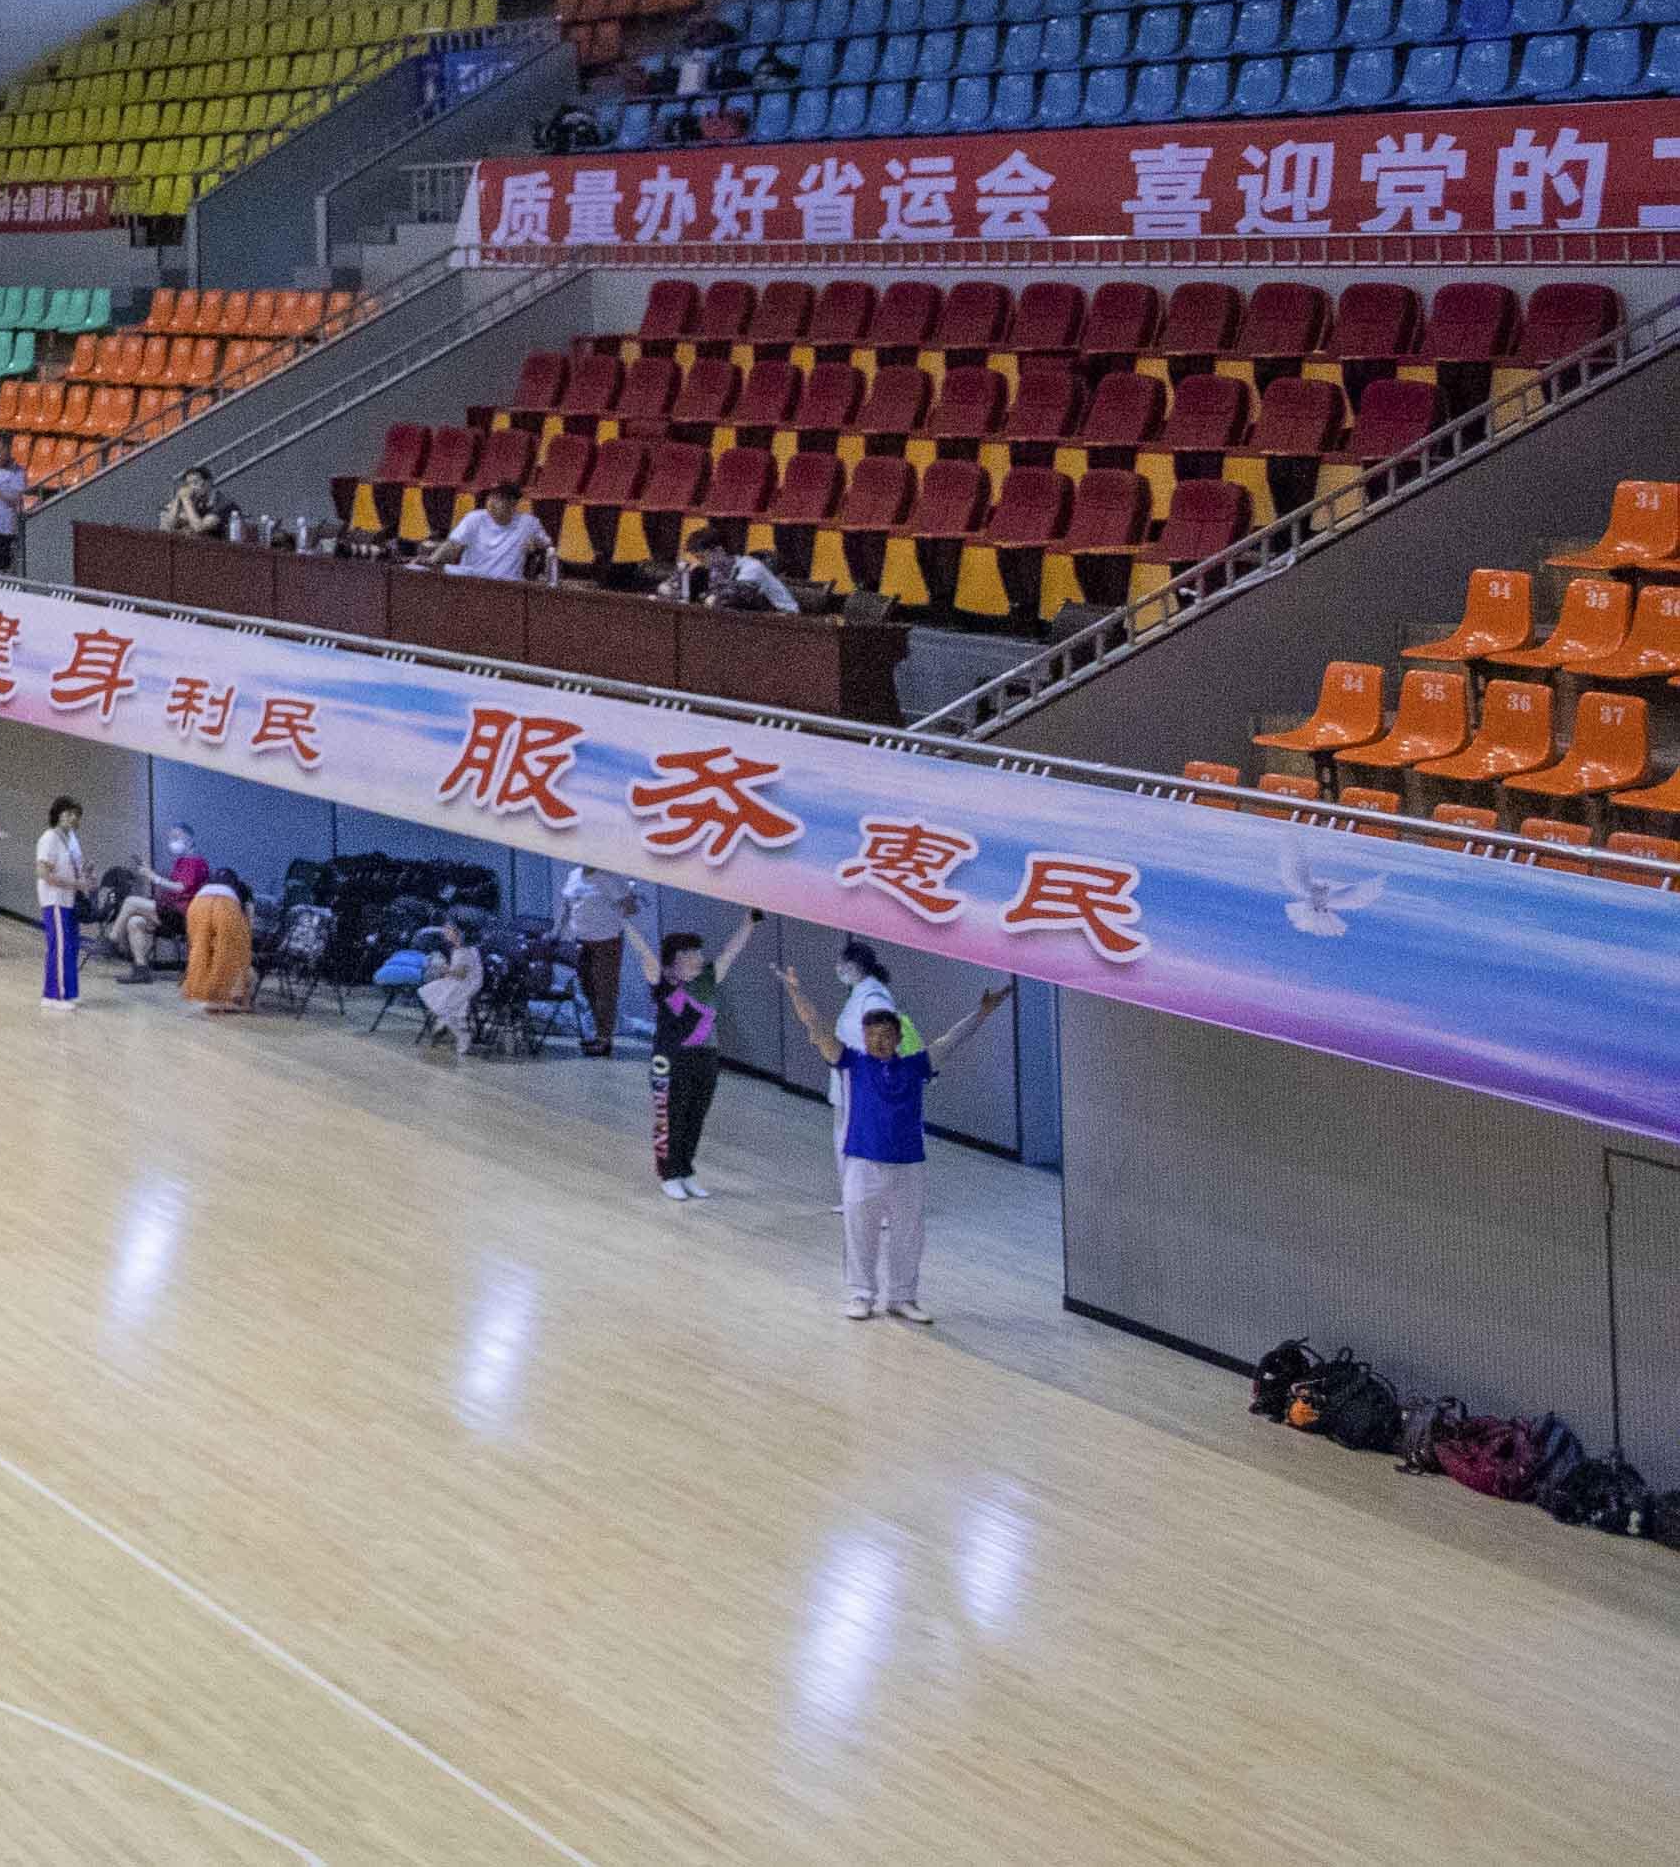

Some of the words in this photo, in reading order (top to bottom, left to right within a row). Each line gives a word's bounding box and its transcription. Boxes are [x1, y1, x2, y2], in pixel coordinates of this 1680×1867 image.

[480, 149, 1054, 247] 质量办好省运会
